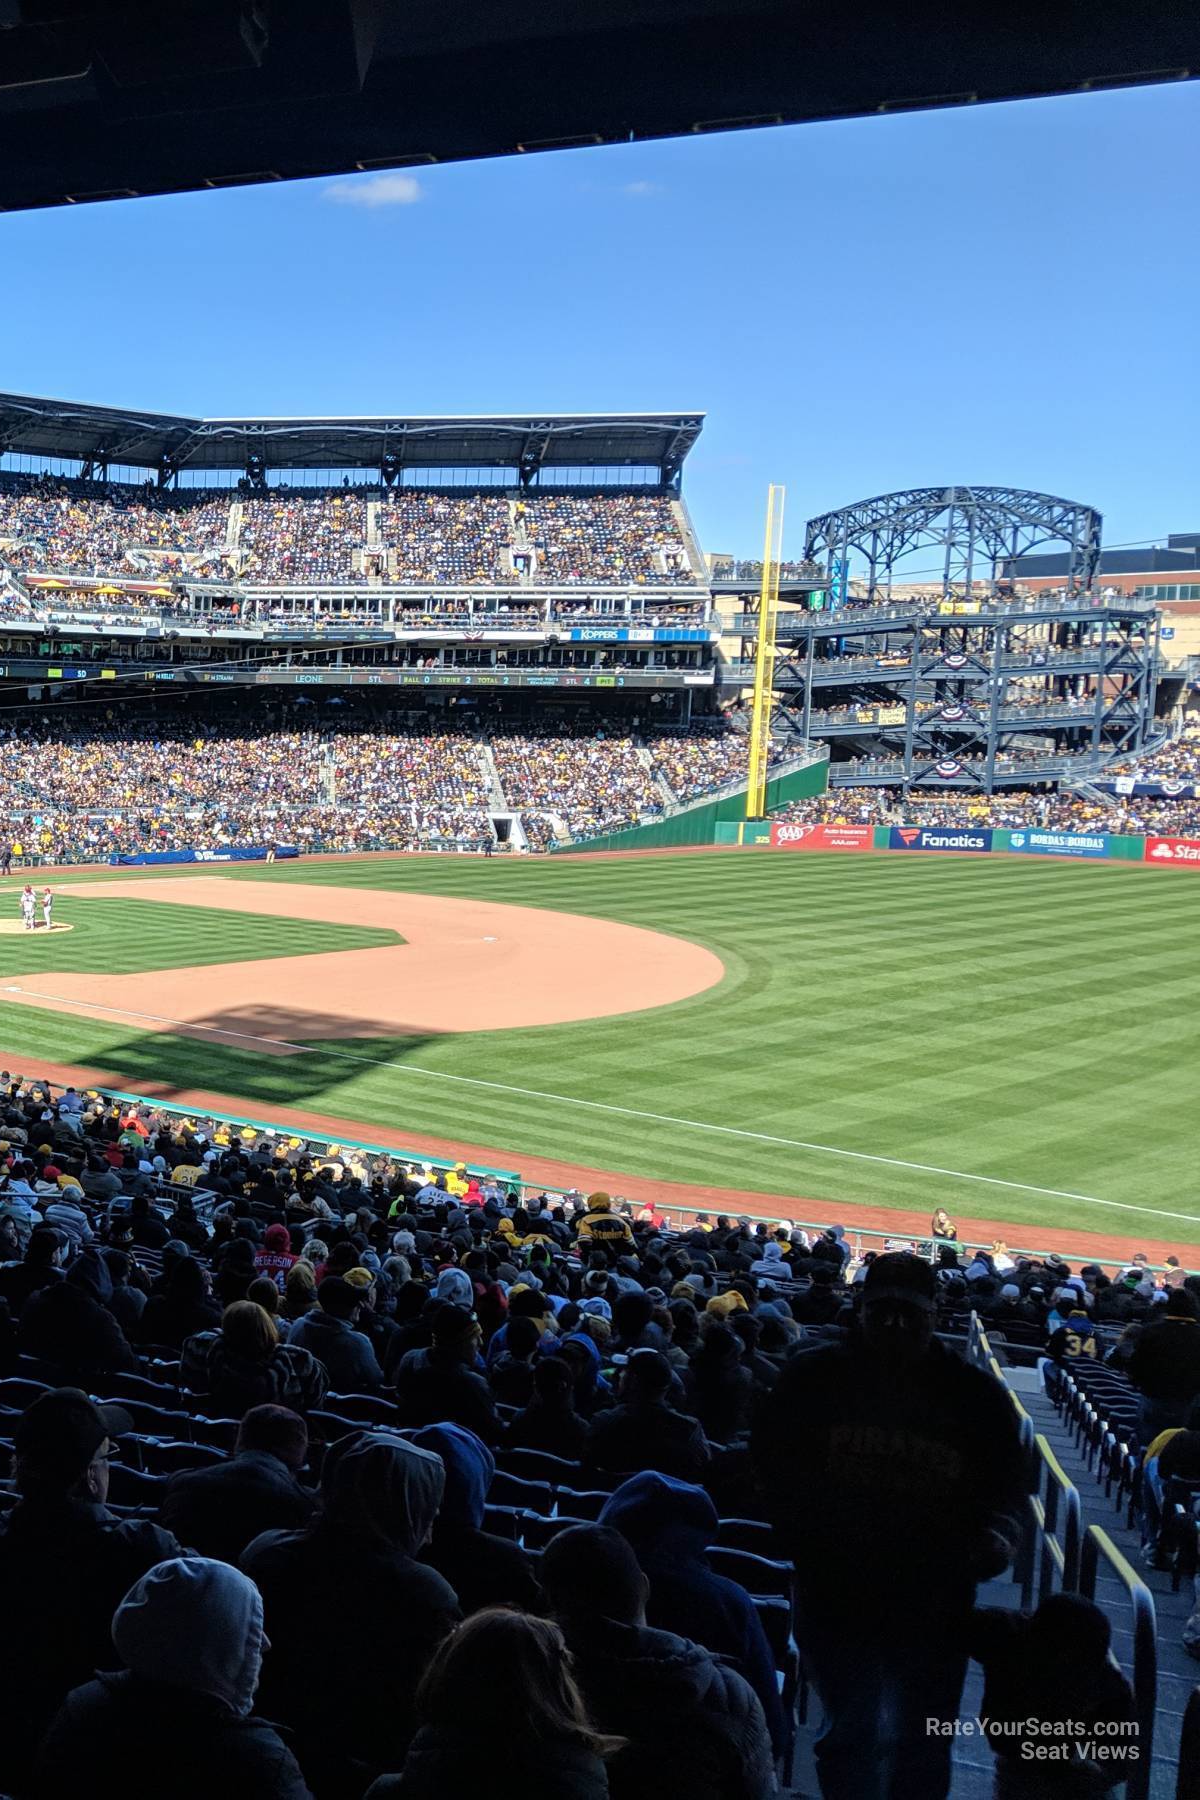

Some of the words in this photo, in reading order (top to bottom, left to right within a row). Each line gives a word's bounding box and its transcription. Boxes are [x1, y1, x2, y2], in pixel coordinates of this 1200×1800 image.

[581, 629, 618, 640] KOPPERS
[77, 669, 87, 678] SD
[295, 674, 324, 683] LEONE
[368, 675, 383, 683] STL
[403, 676, 419, 684] BALL
[424, 675, 431, 684] 0
[438, 676, 460, 684] STRIKE
[465, 675, 471, 684] 2
[478, 676, 497, 684] TOTAL
[503, 676, 510, 685] 2
[584, 677, 590, 685] 4
[618, 677, 624, 686] 3
[780, 826, 801, 839] AAA
[921, 832, 985, 848] Fanatics
[1030, 833, 1064, 845] BORDAS
[1068, 837, 1104, 849] BORDAS
[1064, 1335, 1097, 1359] 34
